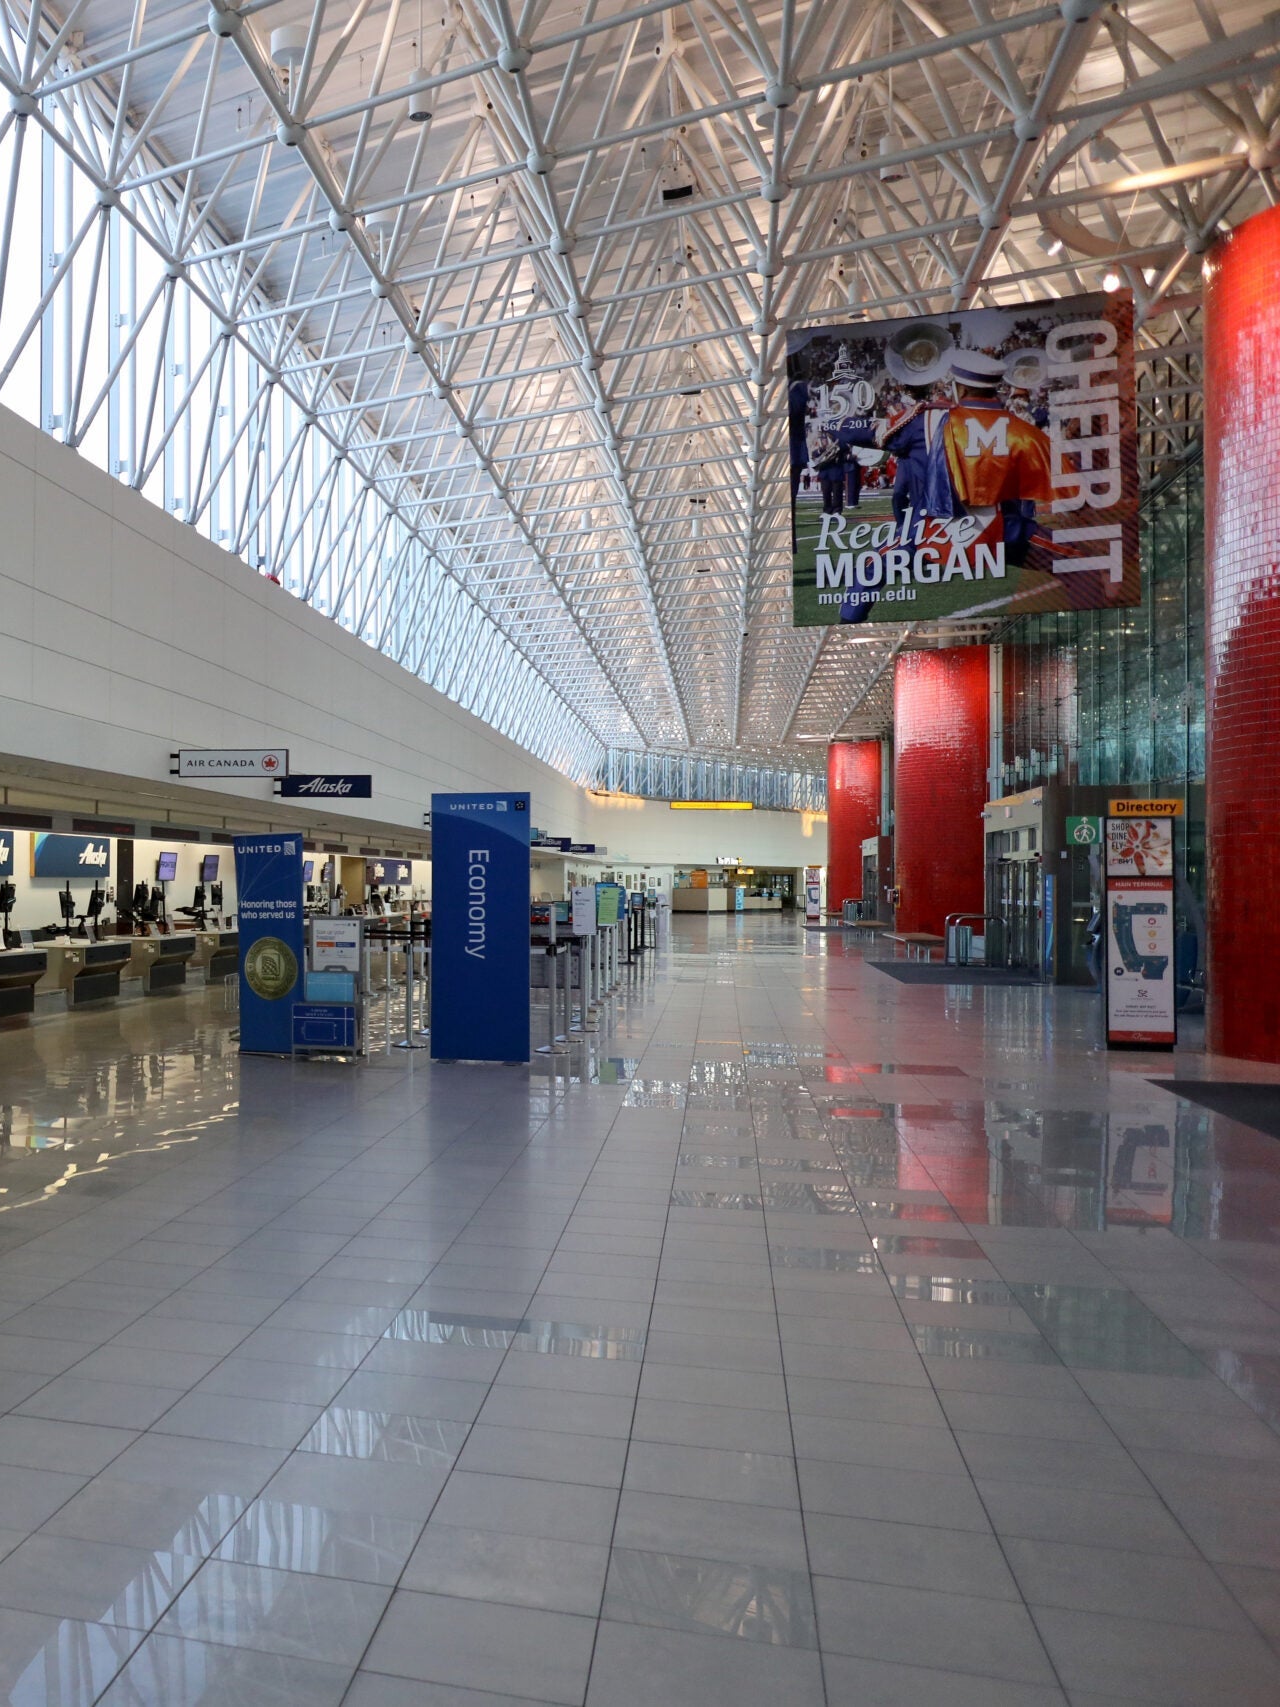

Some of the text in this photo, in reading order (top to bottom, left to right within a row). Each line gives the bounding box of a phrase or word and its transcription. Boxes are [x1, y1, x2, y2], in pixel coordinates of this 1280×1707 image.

[815, 380, 876, 420] 150
[964, 416, 1011, 457] M
[1045, 320, 1124, 583] CHEER IT
[814, 507, 977, 552] Realize
[815, 541, 1007, 590] MORGAN
[818, 586, 917, 606] morgan.edu
[186, 759, 255, 768] AIR CANADA
[298, 777, 353, 795] Alaska
[449, 803, 494, 811] UNITED
[1116, 802, 1177, 814] Directory
[1111, 822, 1130, 831] SHOP
[1111, 832, 1128, 841] DINE
[78, 842, 108, 868] Alaska
[237, 844, 282, 854] UNITED
[240, 899, 297, 911] Honoring those
[464, 849, 490, 960] Economy
[241, 910, 296, 919] who served us
